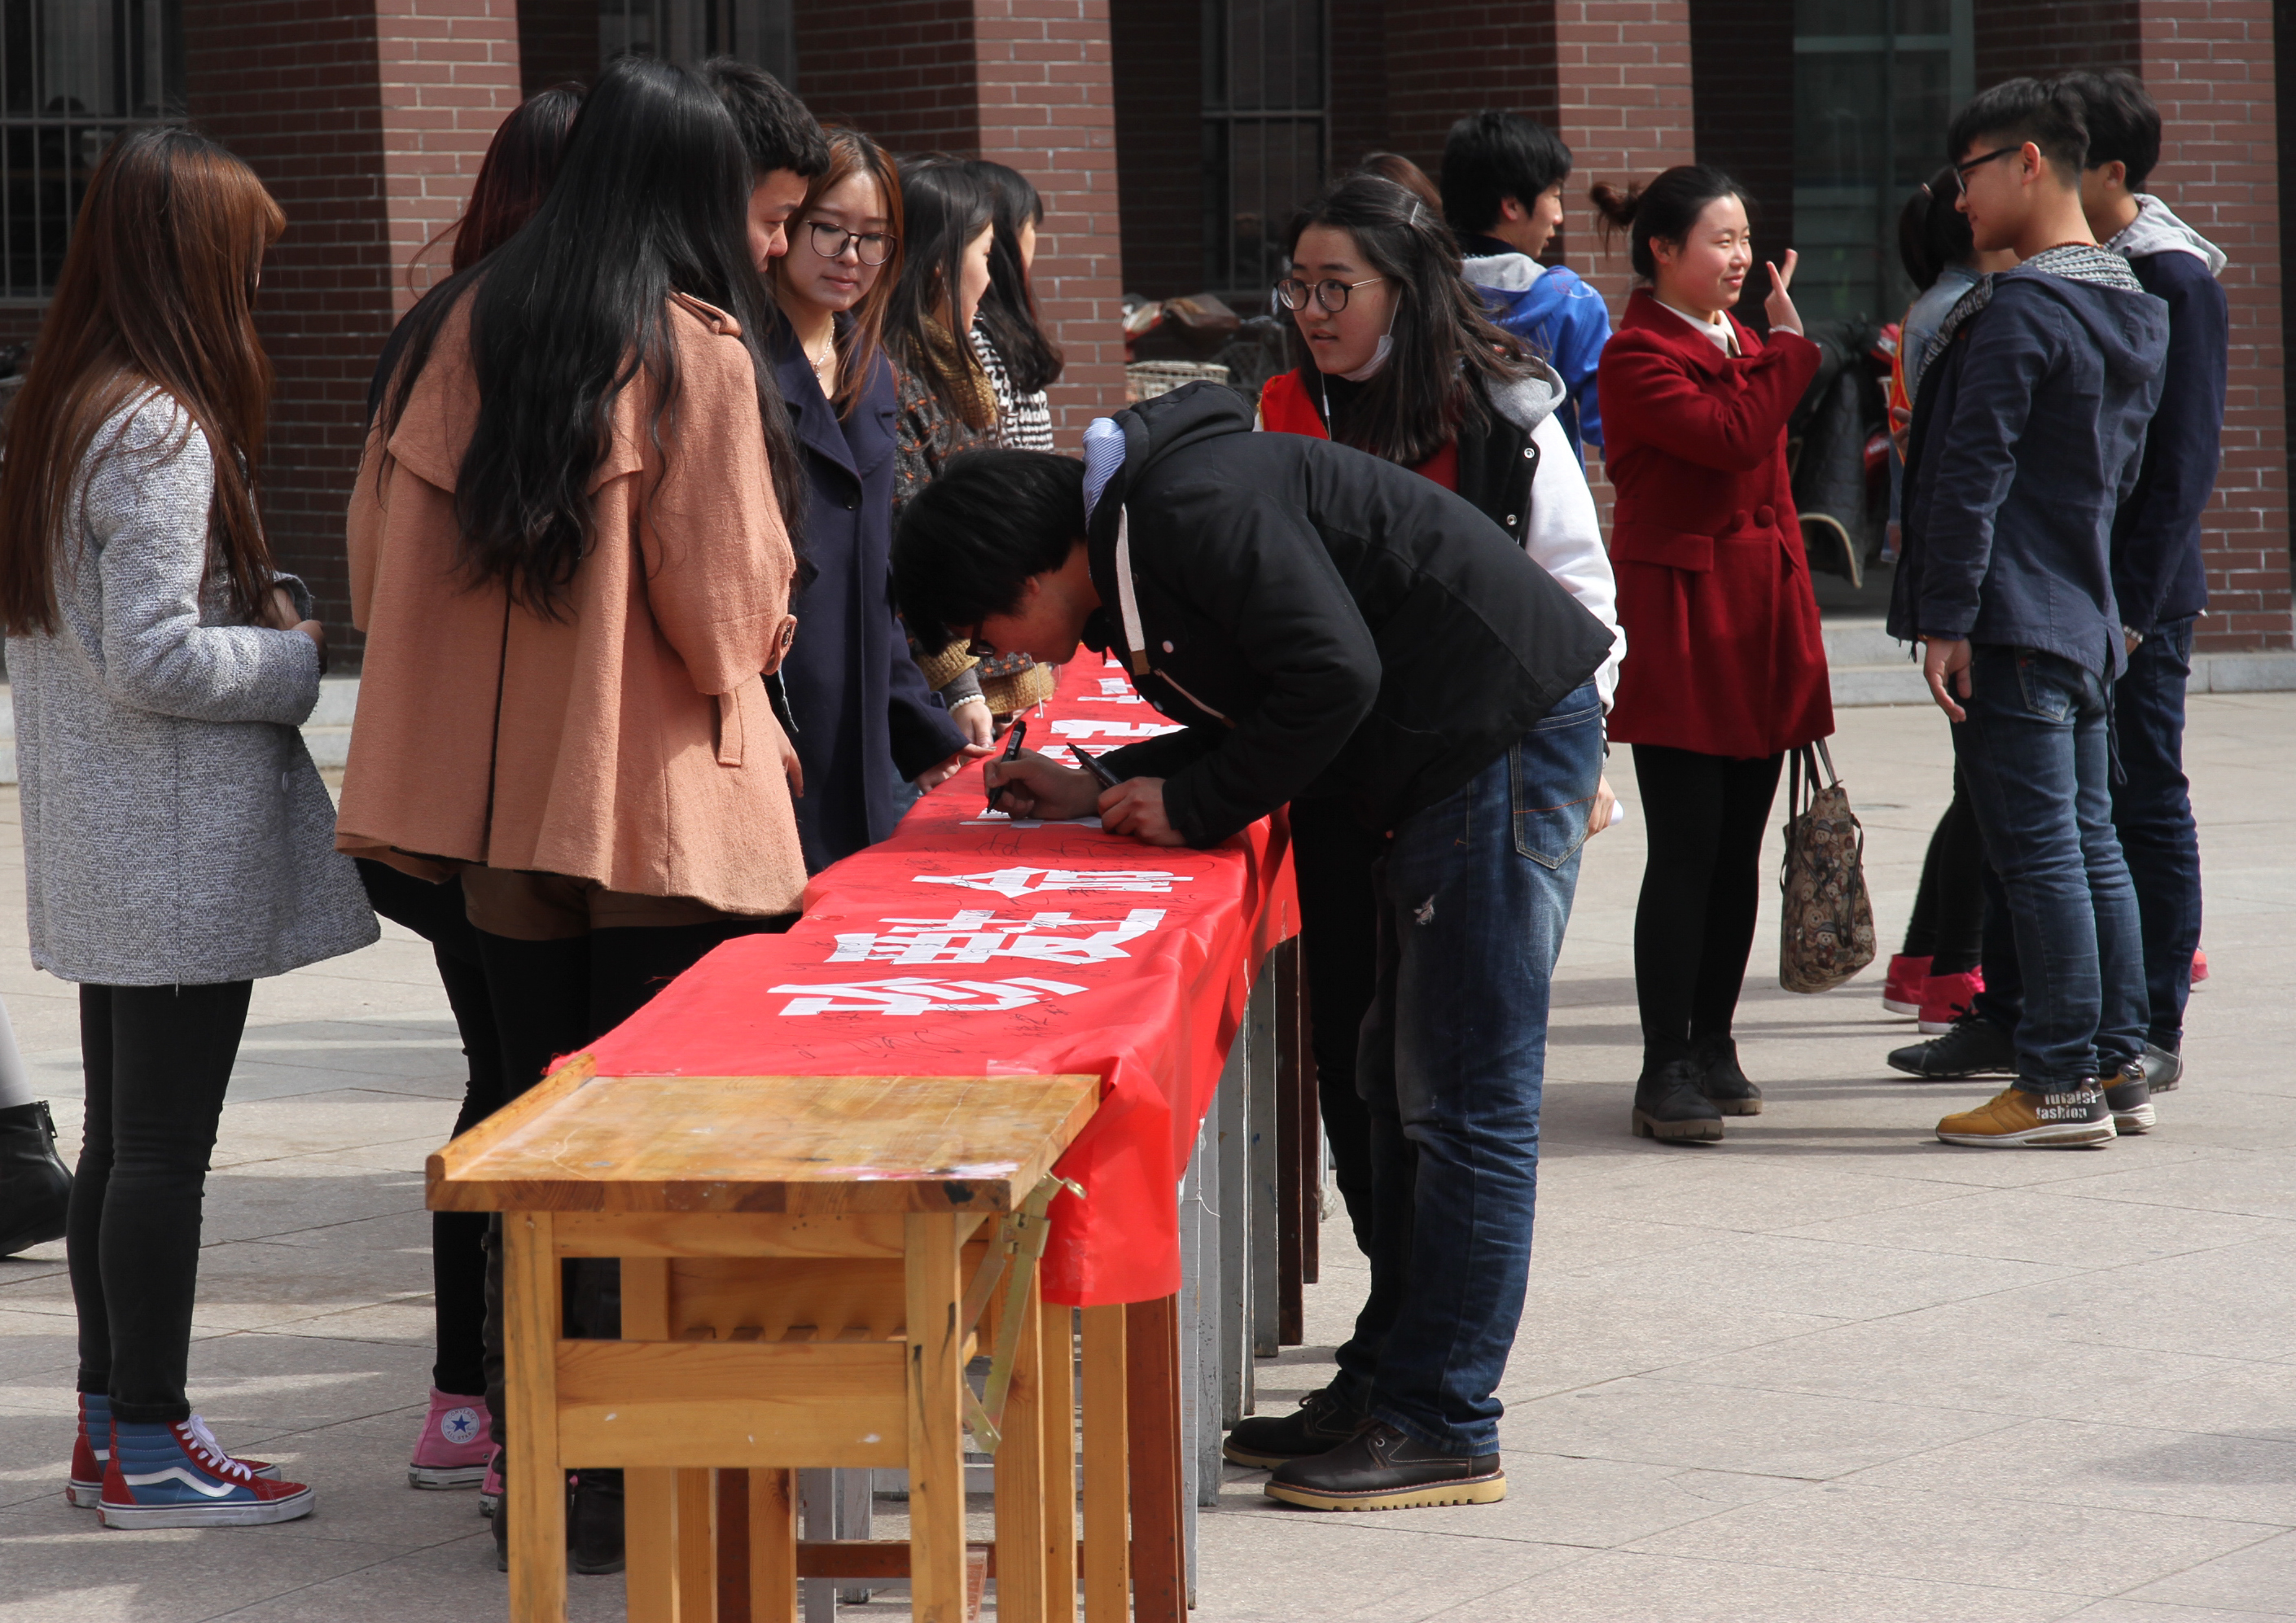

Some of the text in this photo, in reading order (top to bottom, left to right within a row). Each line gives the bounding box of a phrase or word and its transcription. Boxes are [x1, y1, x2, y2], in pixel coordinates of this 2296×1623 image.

[2035, 1105, 2088, 1120] fashion
[447, 1409, 475, 1419] CONVERSE
[446, 1431, 472, 1441] ALL STAR
